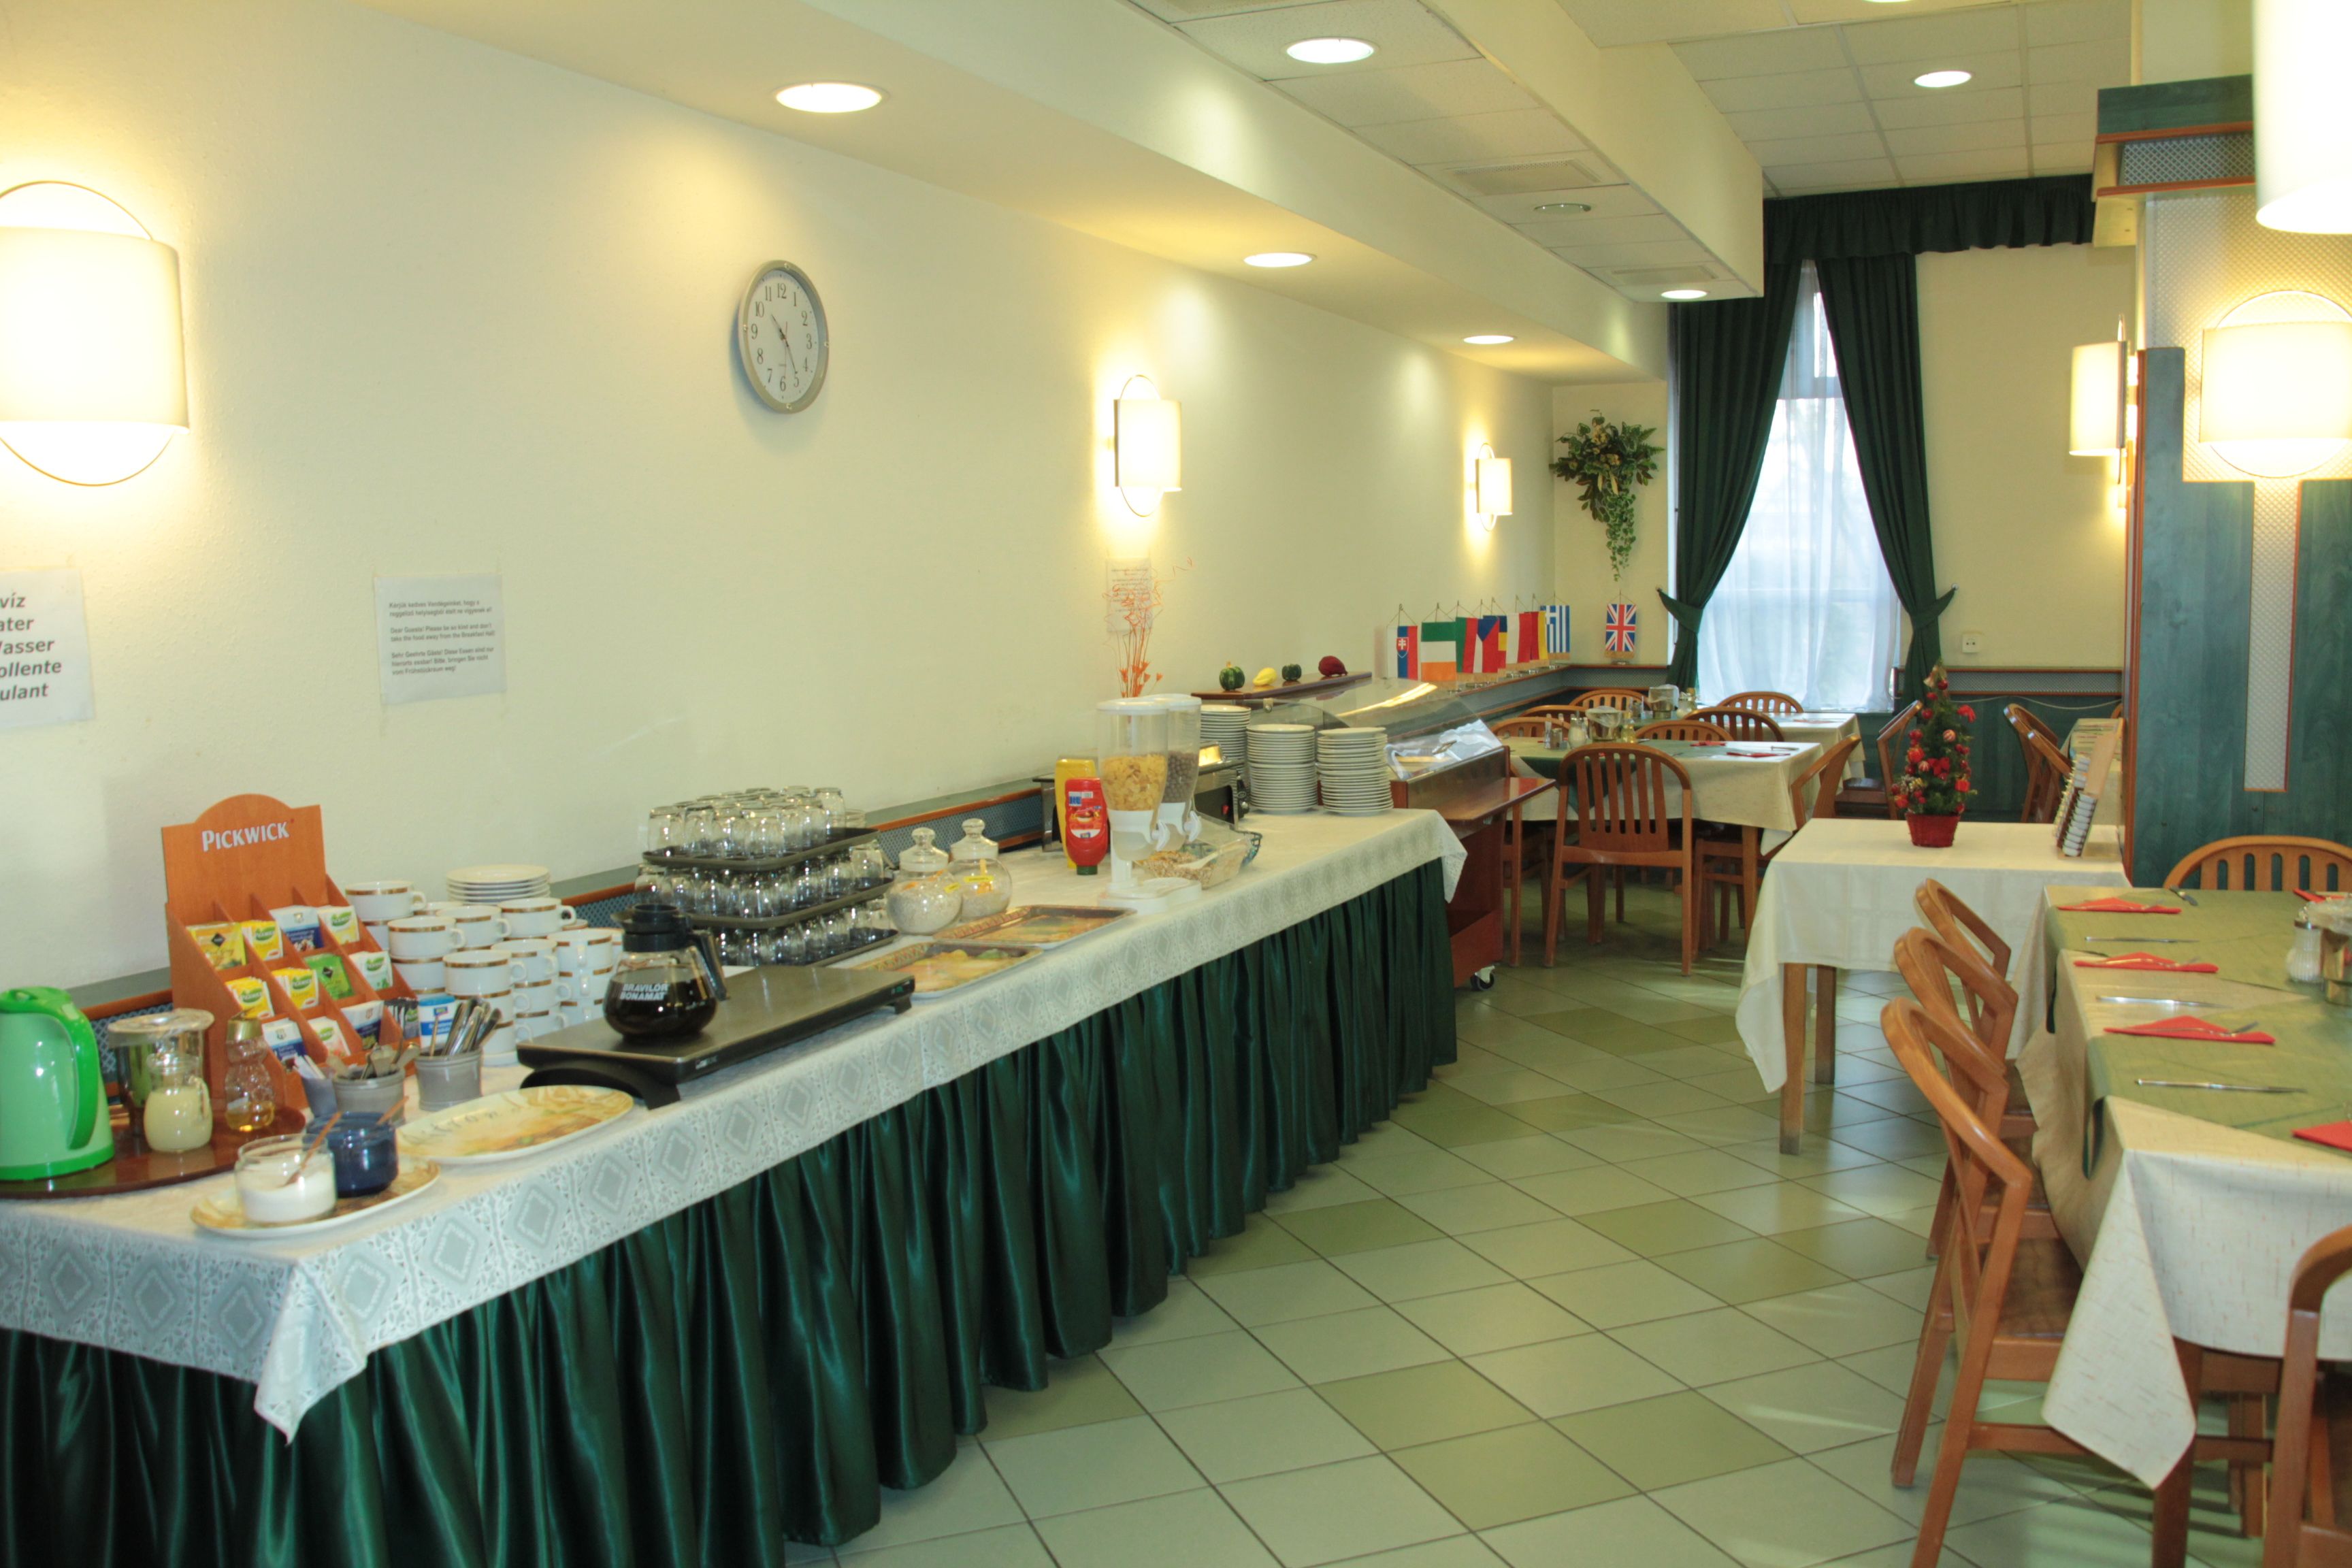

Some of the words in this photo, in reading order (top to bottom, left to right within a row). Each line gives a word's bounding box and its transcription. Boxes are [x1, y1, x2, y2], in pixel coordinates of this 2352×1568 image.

[765, 285, 772, 301] 11
[777, 282, 787, 299] 12
[755, 301, 764, 318] 10
[801, 310, 808, 327] 2
[751, 323, 758, 340] 9
[806, 333, 813, 350] 3
[757, 348, 764, 365] 8
[803, 357, 808, 372] 4
[767, 368, 773, 383] 7
[780, 376, 786, 392] 6
[201, 821, 290, 852] PICKWICK
[620, 992, 665, 1000] BONAMAT
[622, 983, 669, 992] BRAVILOR
